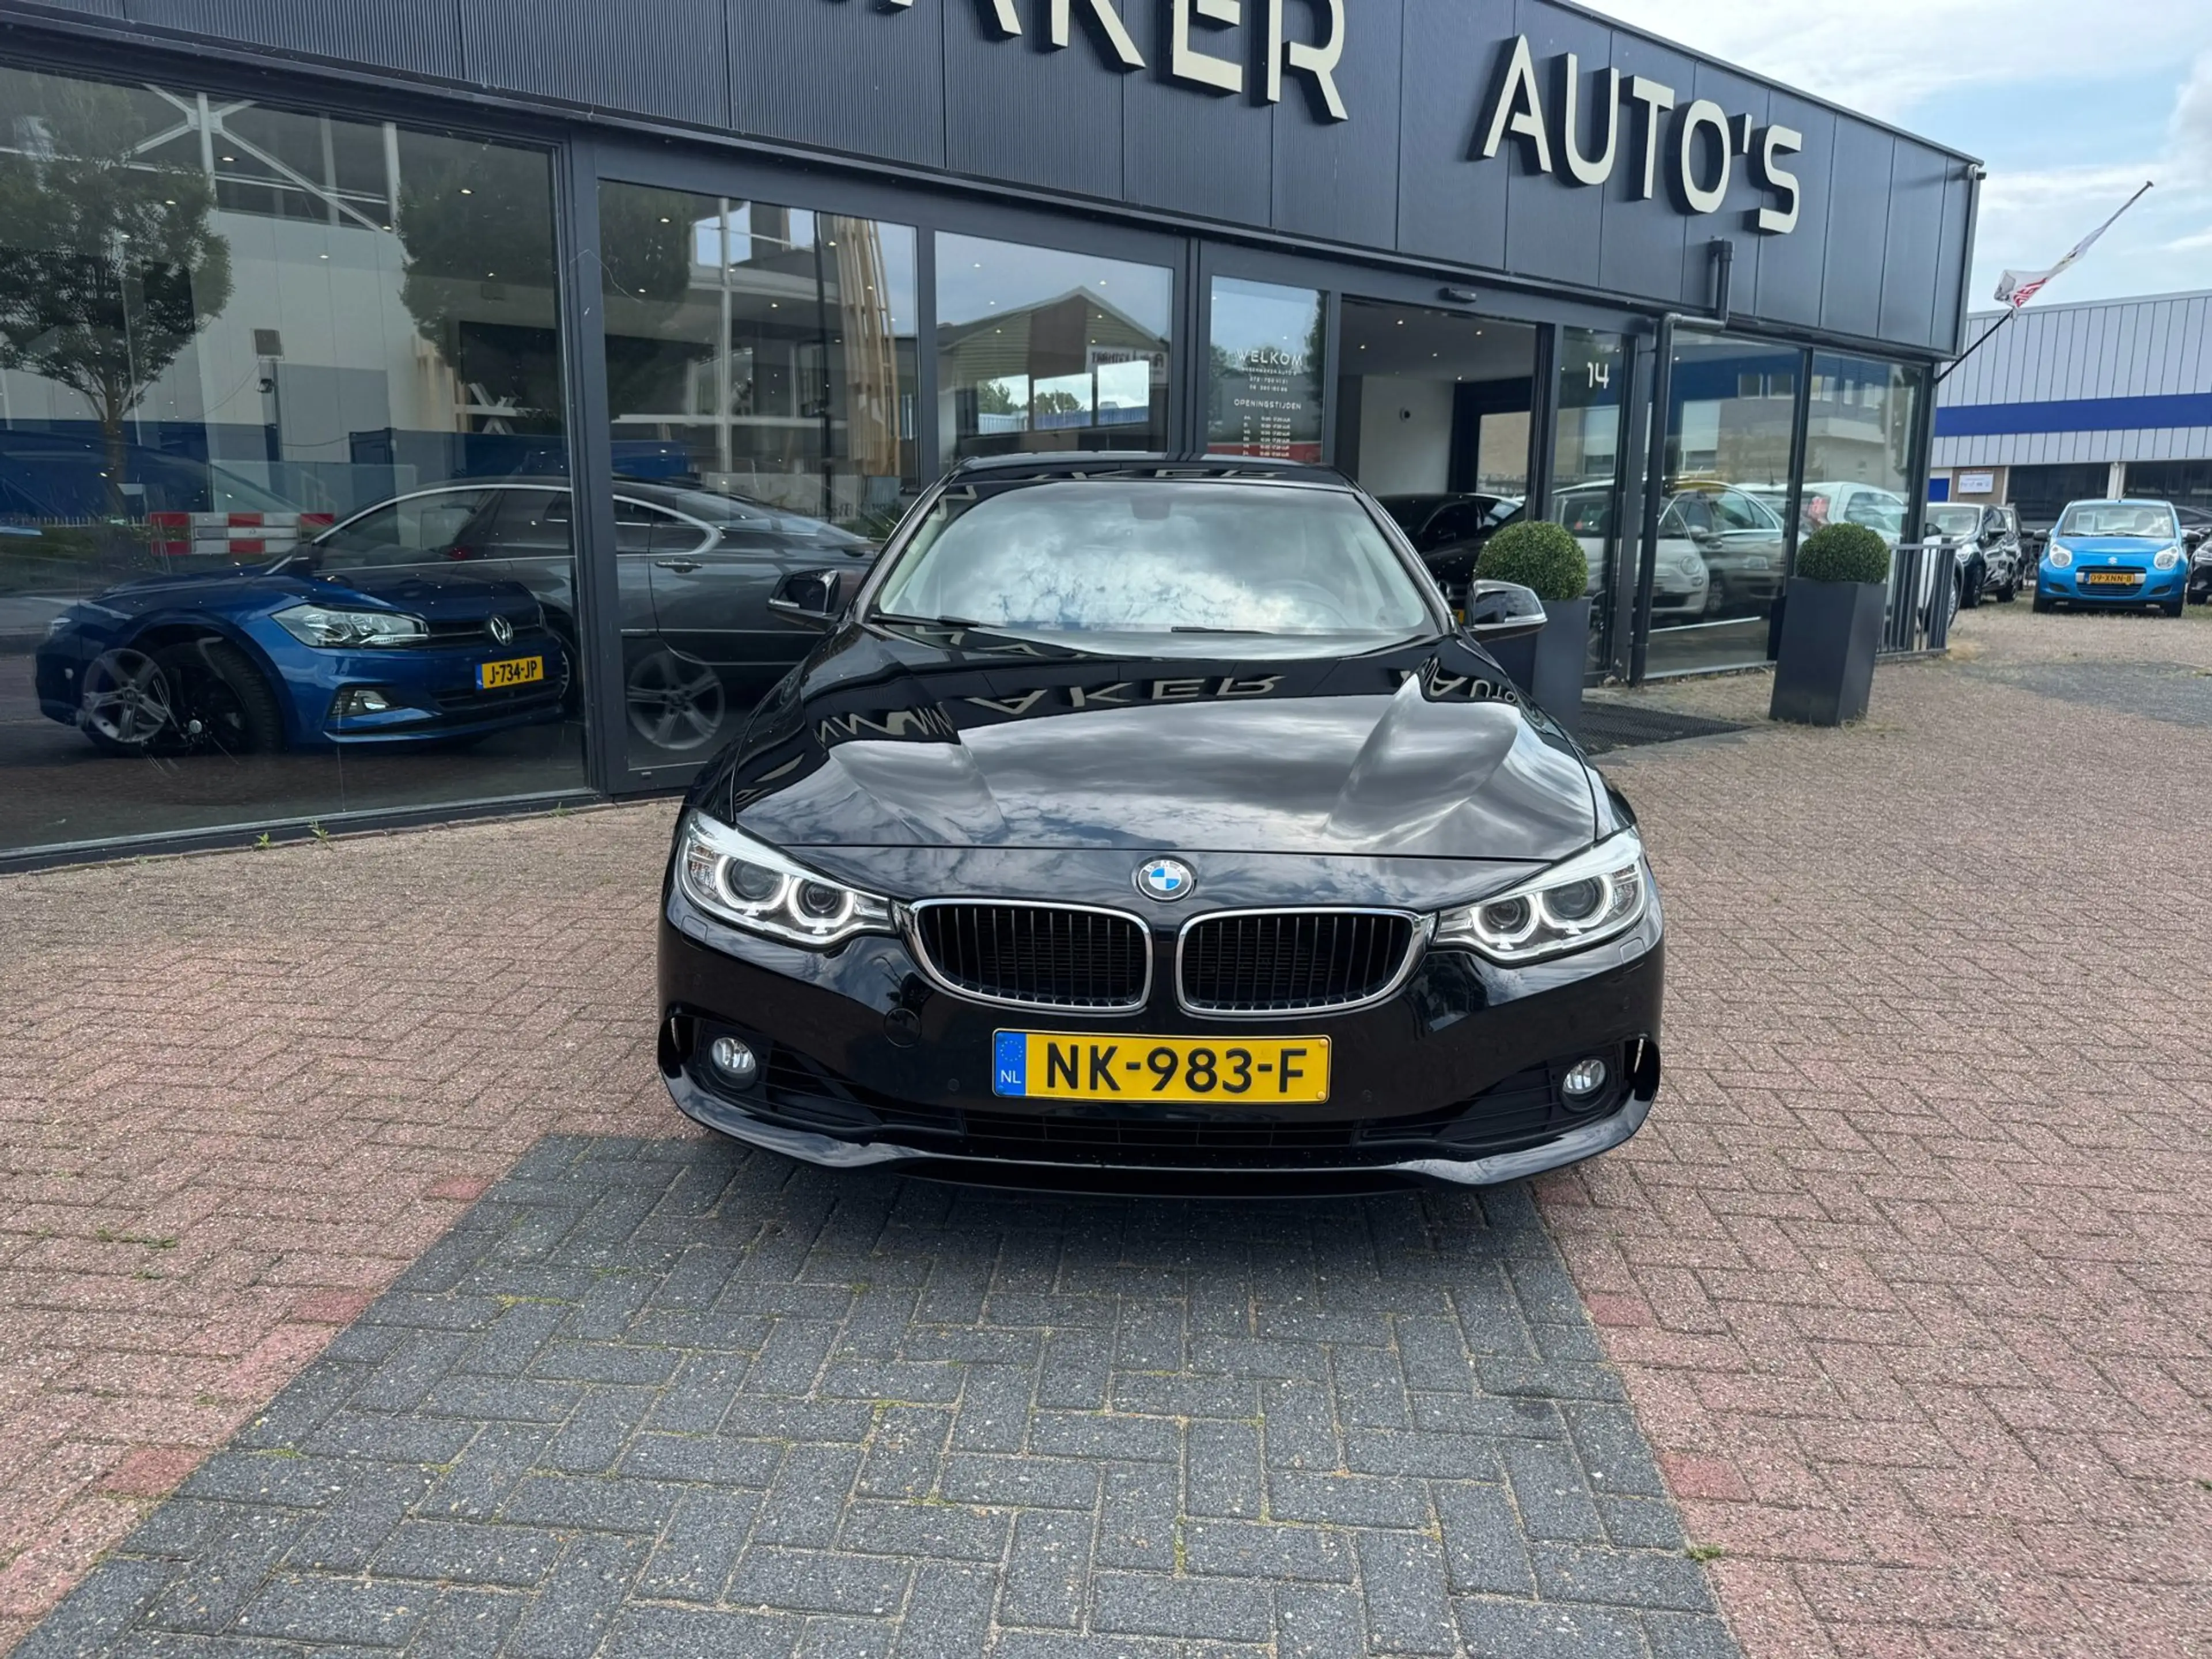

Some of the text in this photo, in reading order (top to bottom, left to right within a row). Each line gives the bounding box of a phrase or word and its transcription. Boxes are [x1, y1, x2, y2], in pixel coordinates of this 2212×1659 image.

[1483, 33, 1802, 234] AUTO'S
[1236, 348, 1303, 366] WELKOM
[1588, 362, 1609, 389] 14
[1234, 398, 1302, 410] OPENINGSTIJDEN
[490, 660, 537, 684] J-734-JP
[1000, 1042, 1307, 1093] NL NK-983-F
